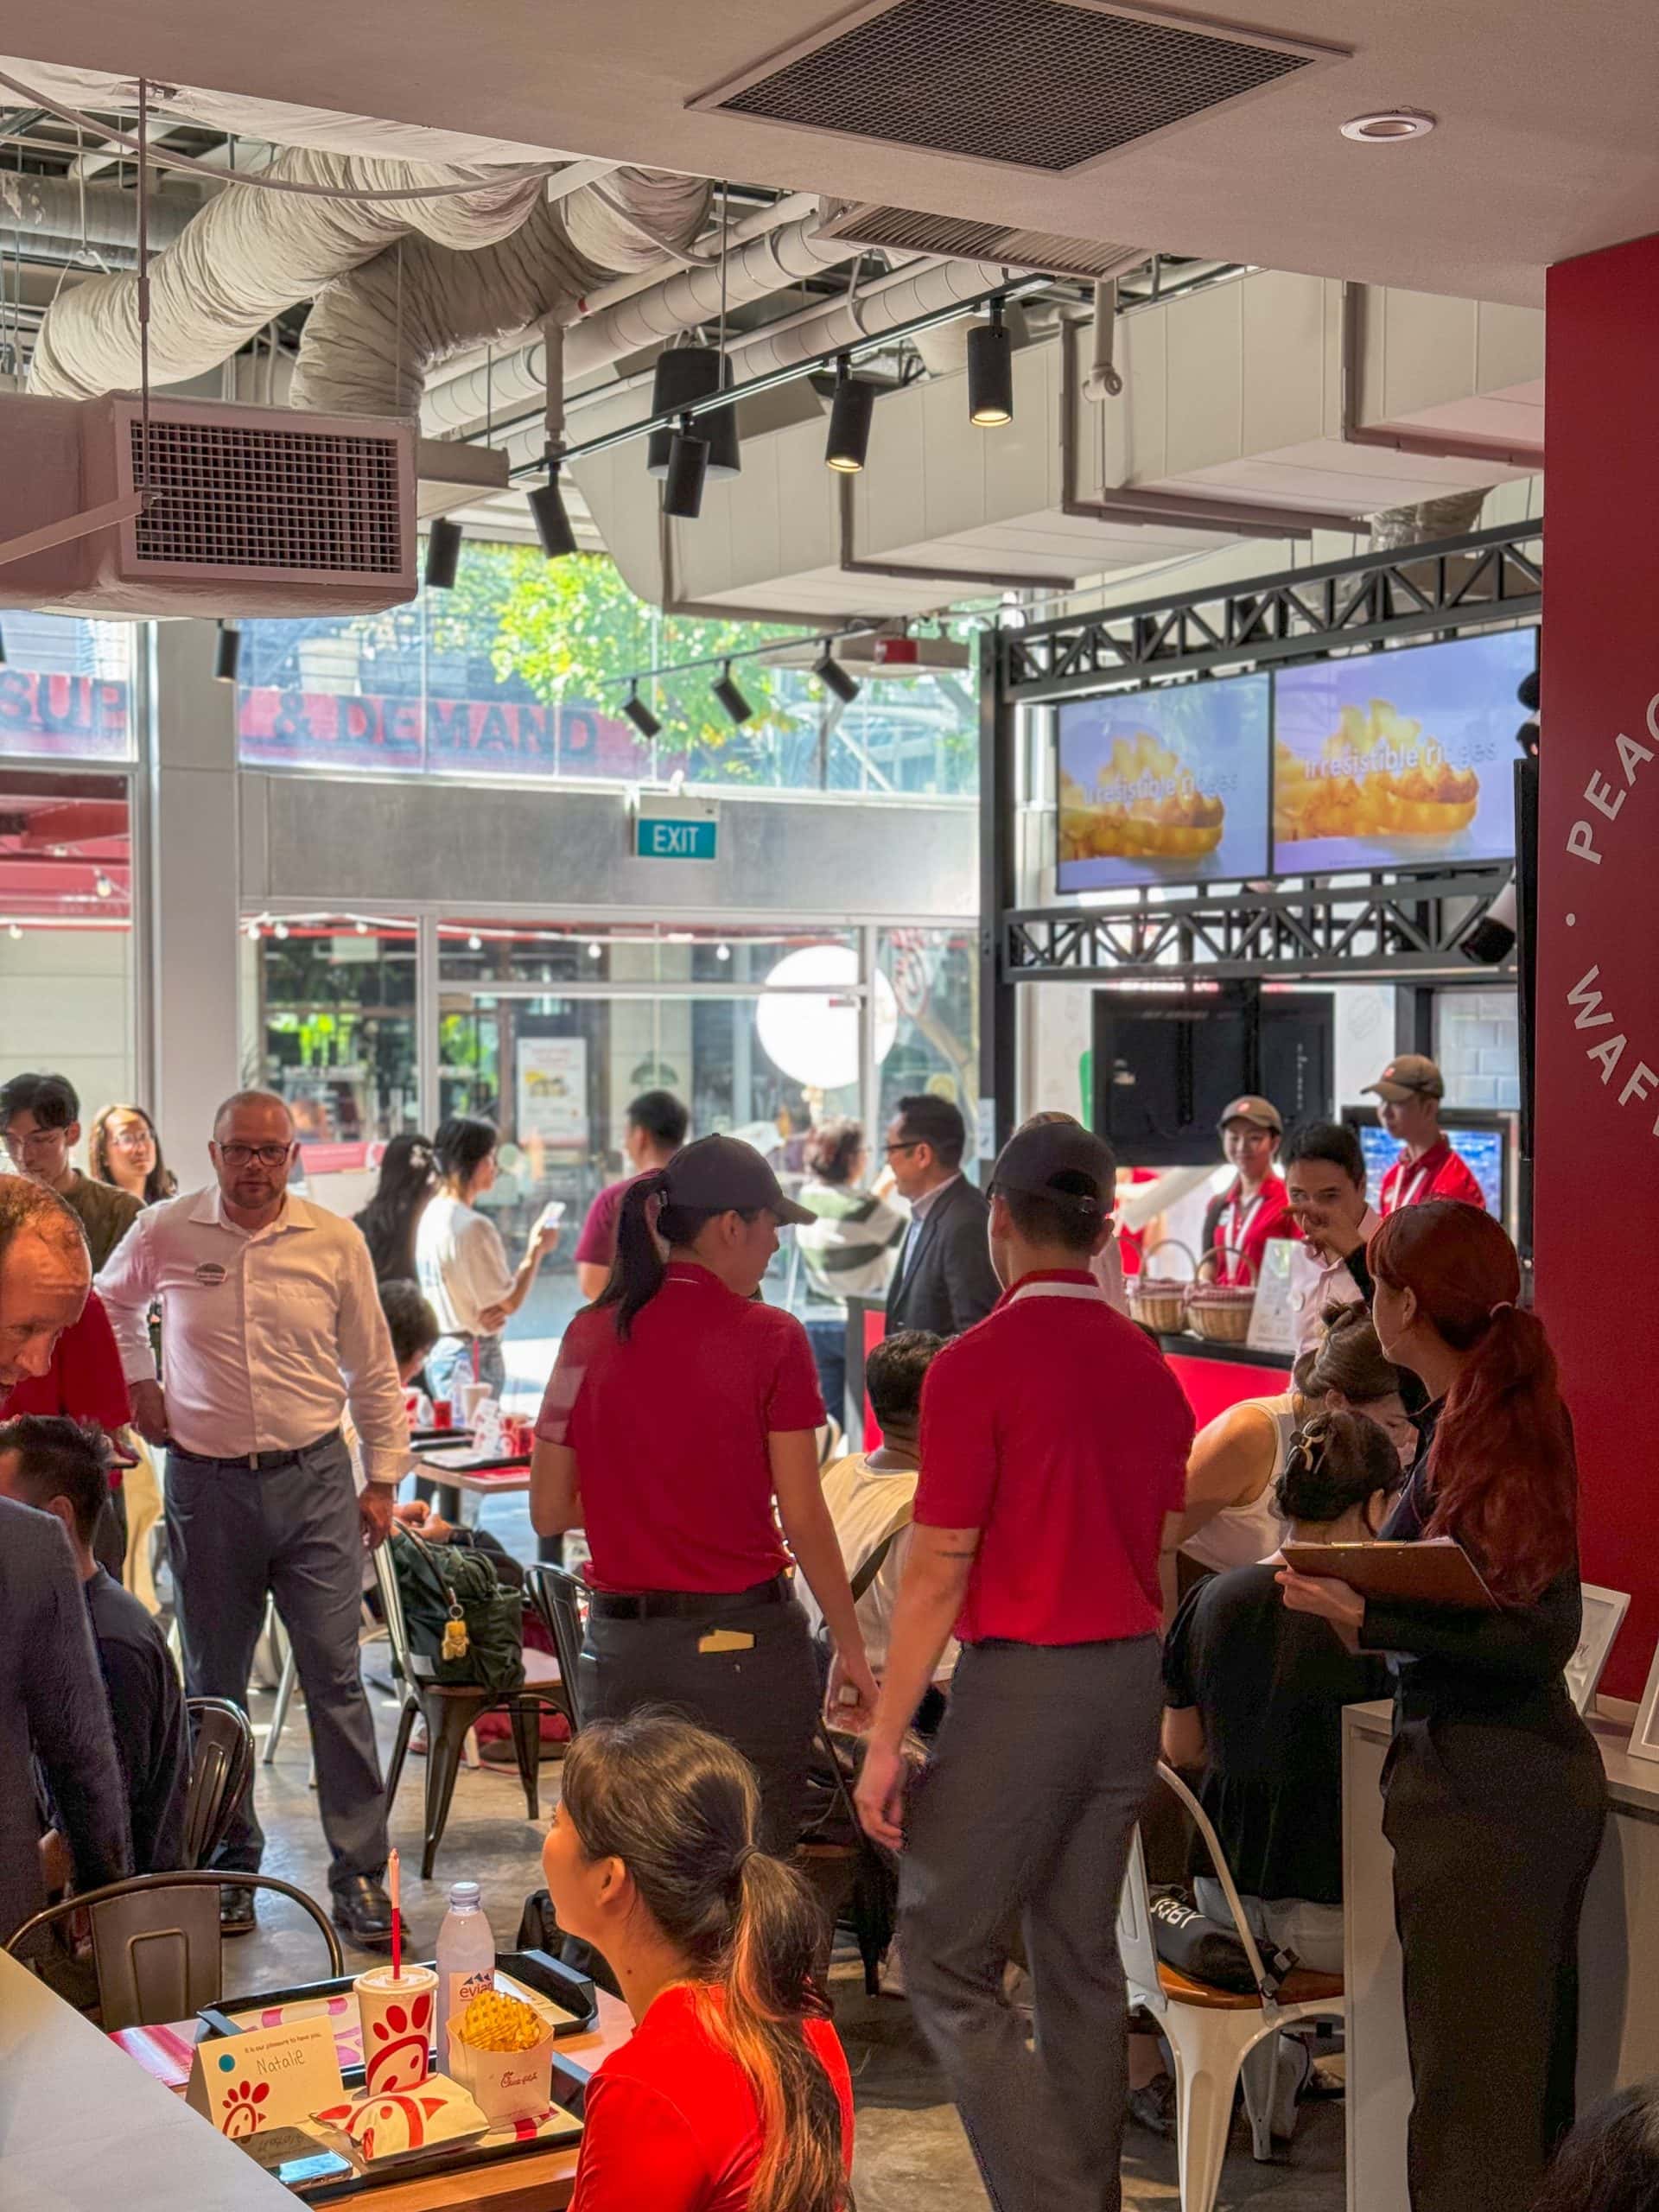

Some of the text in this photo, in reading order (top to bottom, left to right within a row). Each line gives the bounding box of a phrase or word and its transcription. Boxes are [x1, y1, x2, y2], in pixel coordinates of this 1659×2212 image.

[274, 690, 312, 741] &
[336, 694, 598, 758] DEMAND
[652, 823, 699, 854] EXIT
[460, 1982, 492, 1999] evia
[257, 2050, 304, 2074] Natalie
